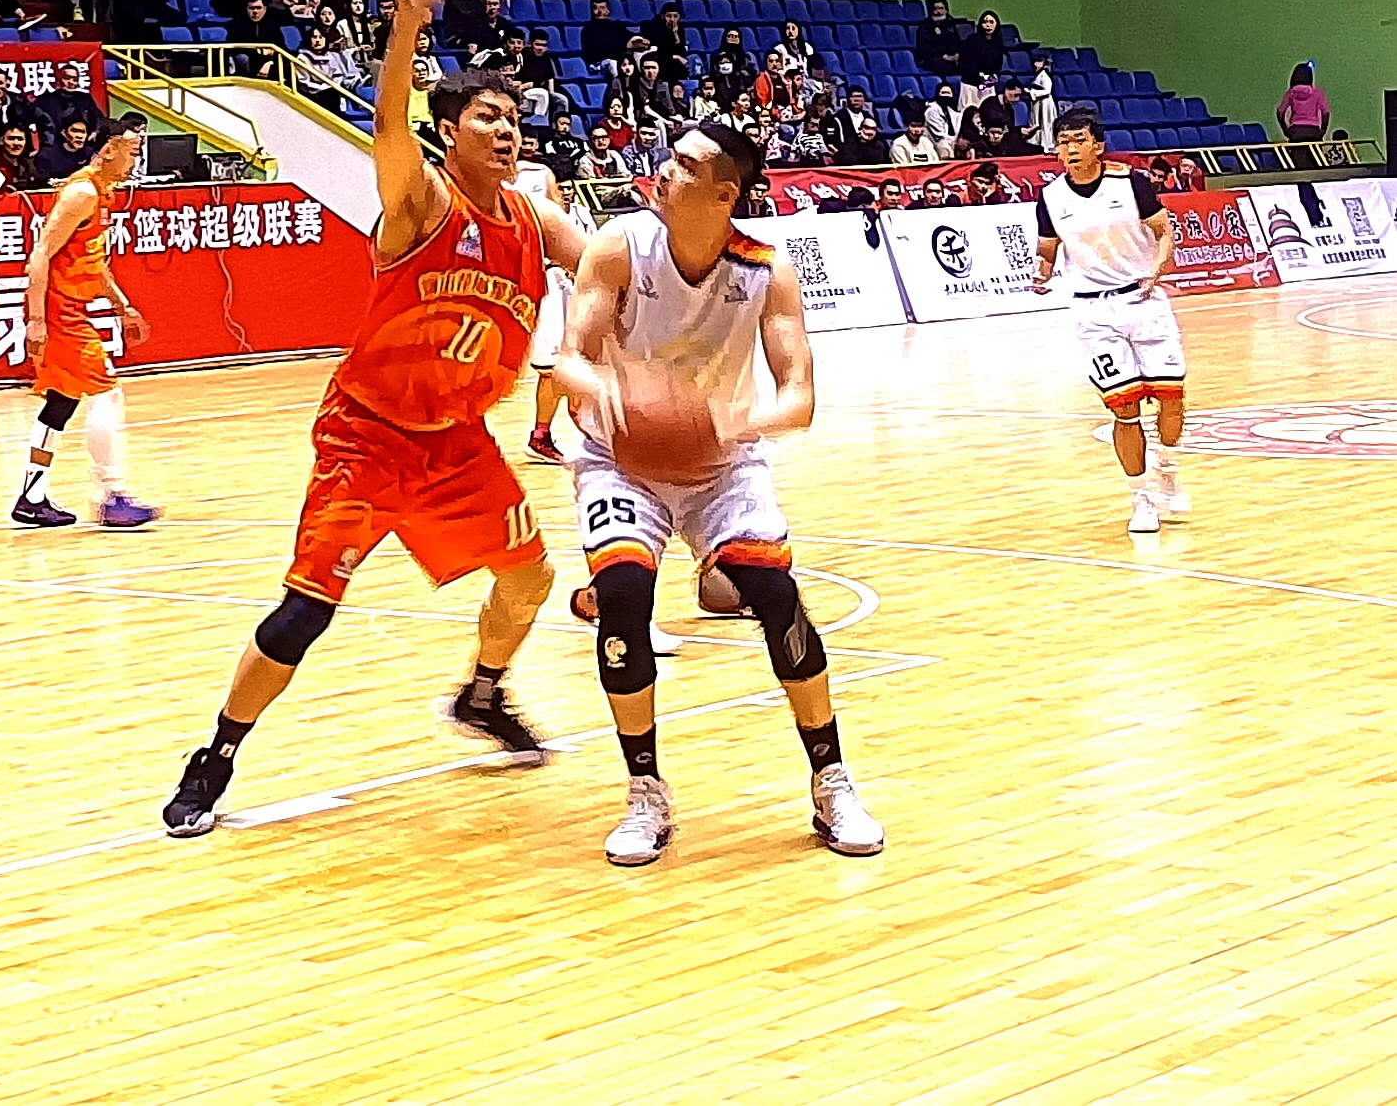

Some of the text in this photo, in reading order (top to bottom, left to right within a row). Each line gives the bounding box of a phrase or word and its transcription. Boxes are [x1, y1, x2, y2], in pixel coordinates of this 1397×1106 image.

[440, 314, 492, 363] 10
[1091, 352, 1121, 381] 12
[505, 500, 539, 551] 10
[587, 496, 637, 534] 25
